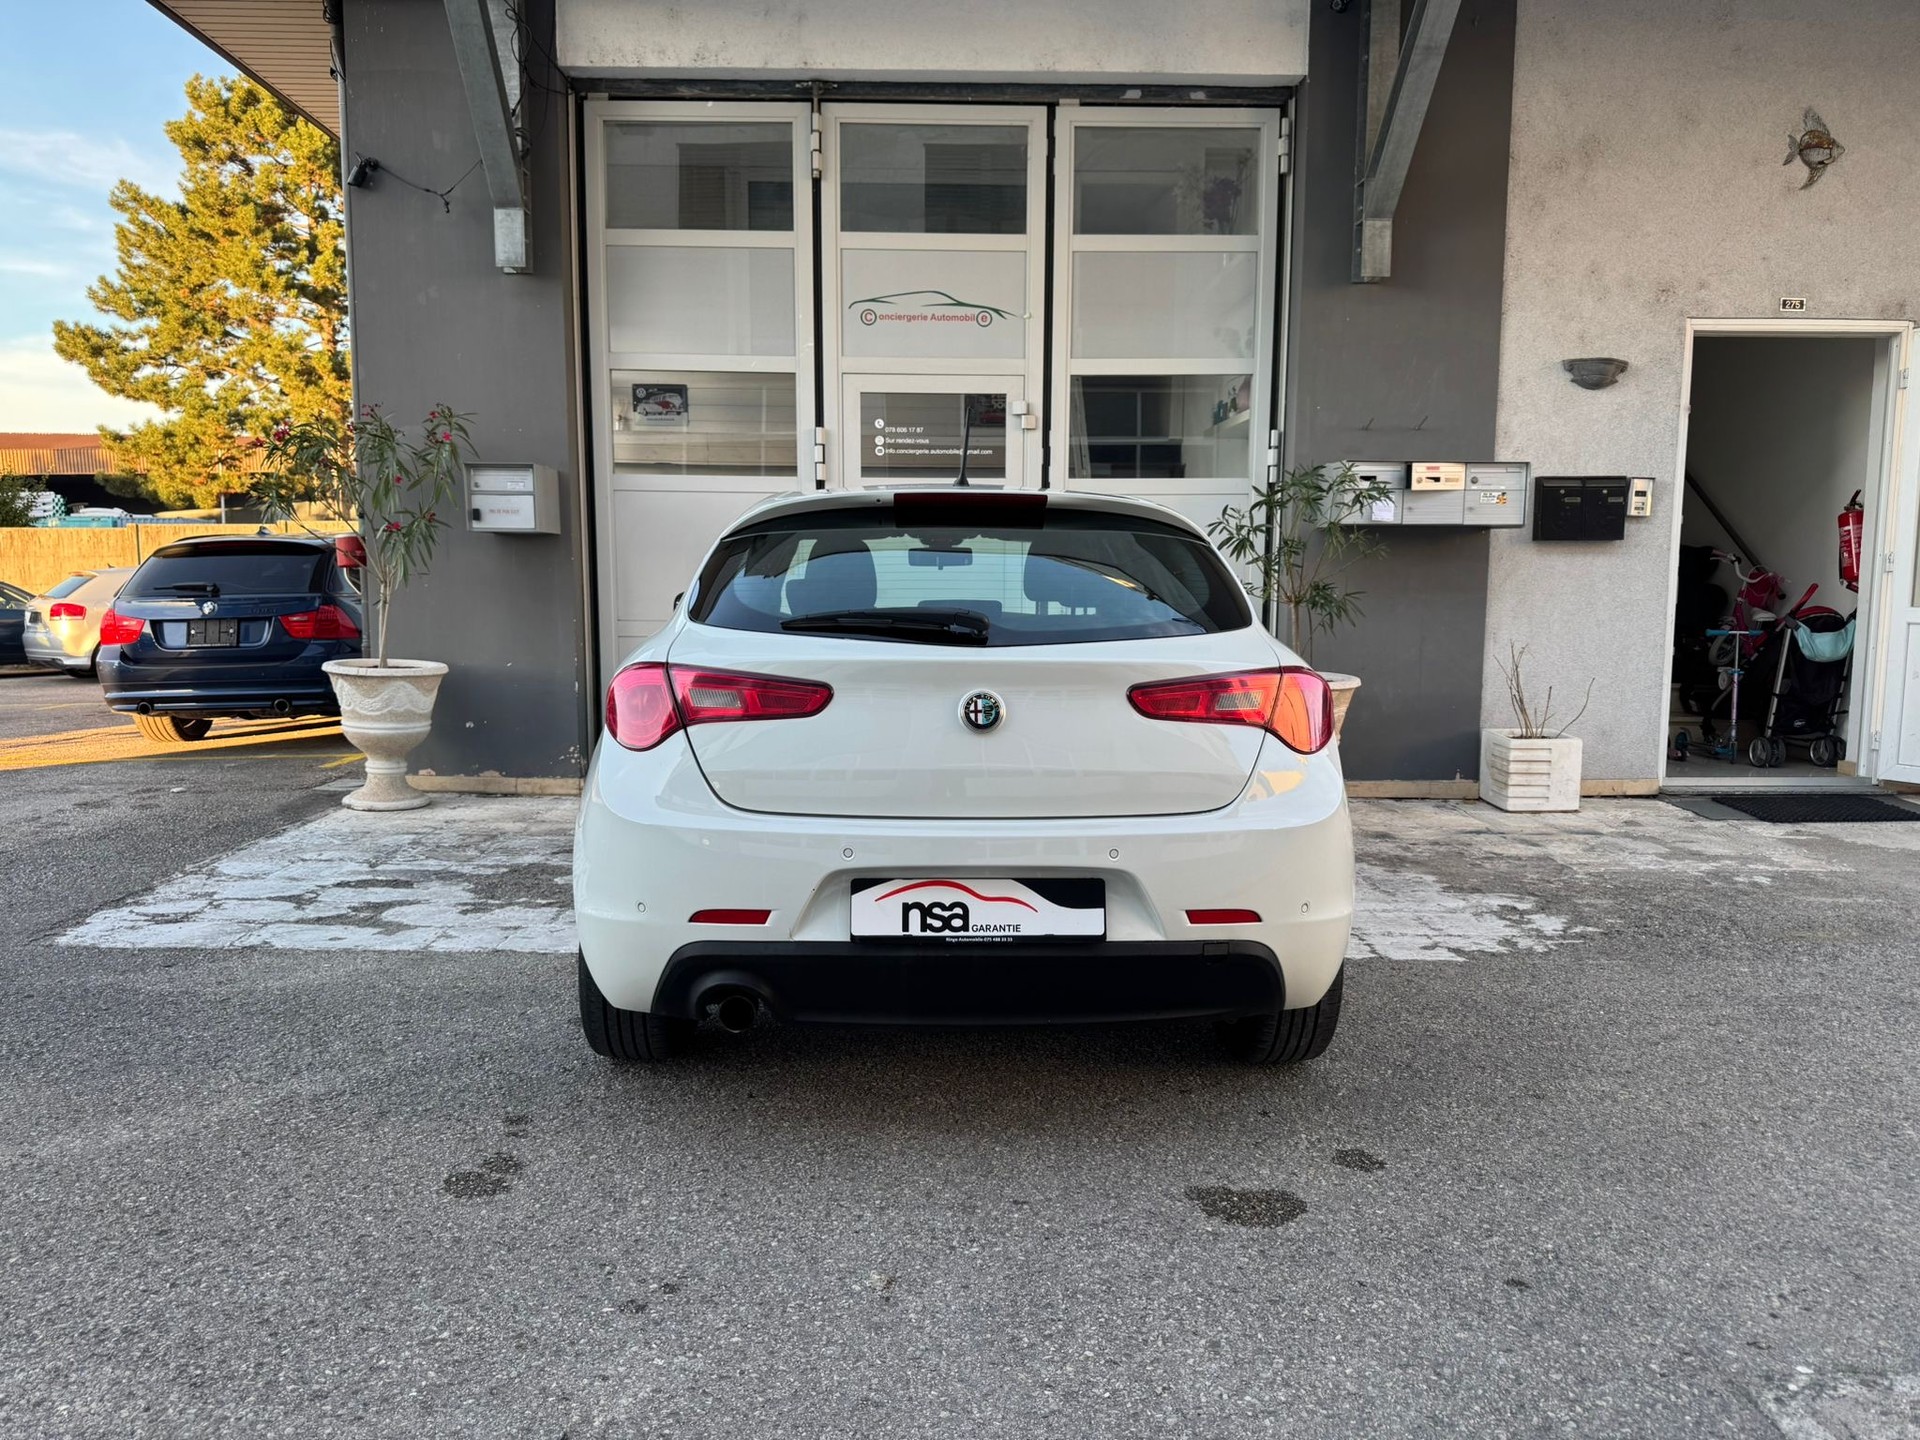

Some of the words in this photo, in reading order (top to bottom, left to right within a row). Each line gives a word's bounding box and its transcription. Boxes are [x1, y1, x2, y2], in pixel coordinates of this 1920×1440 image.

[1785, 300, 1801, 309] 275
[862, 311, 928, 323] Conciergerie
[930, 312, 990, 324] Automobile
[902, 901, 970, 933] nsa
[971, 924, 1022, 933] GARANTIE
